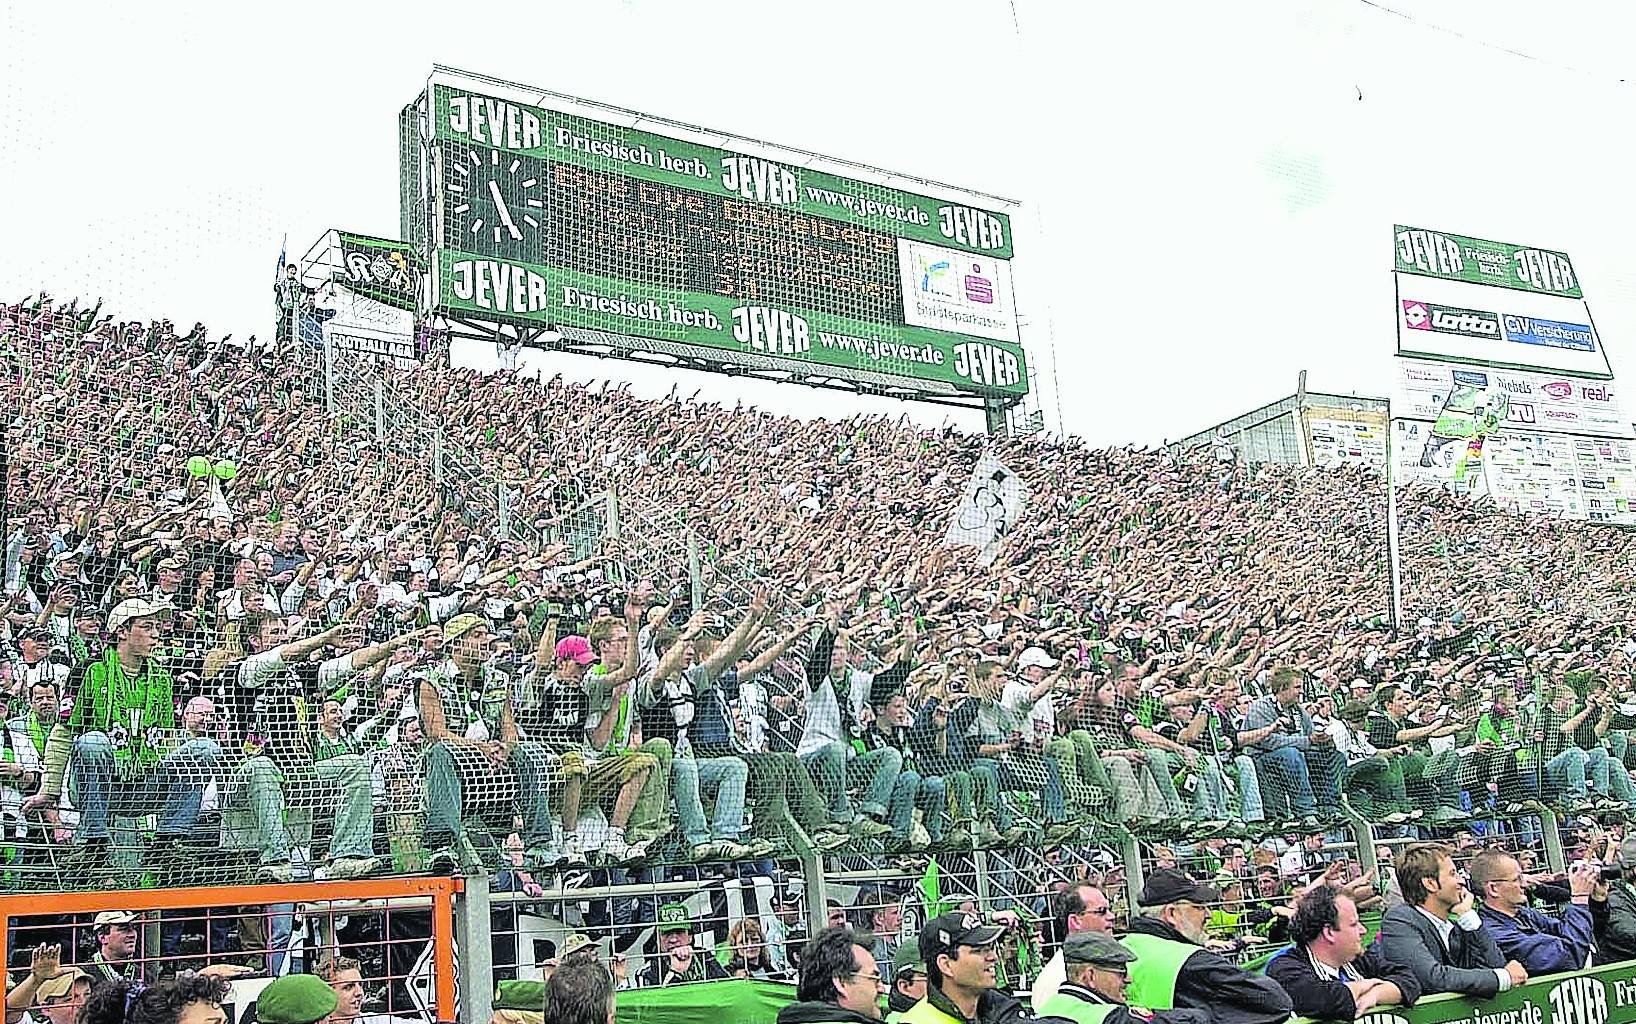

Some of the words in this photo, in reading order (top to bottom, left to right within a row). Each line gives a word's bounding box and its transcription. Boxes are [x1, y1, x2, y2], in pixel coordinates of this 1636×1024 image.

[448, 96, 542, 150] JEVER
[555, 126, 656, 165] Friesisch
[658, 149, 712, 179] herb.
[720, 156, 798, 205] JEVER
[805, 185, 930, 227] www.jever.de
[937, 204, 1005, 250] JEVER
[1397, 229, 1464, 274] JEVER
[1513, 249, 1575, 291] JEVER
[332, 333, 387, 353] FOOTBALL
[453, 260, 547, 313] JEVER
[562, 286, 662, 321] Friesisch
[667, 303, 723, 331] herb.
[730, 306, 810, 354] JEVER
[818, 331, 945, 366] www.jever.de
[953, 342, 1021, 387] JEVER
[1431, 309, 1497, 335] Lotto
[1549, 976, 1609, 1024] JEVER
